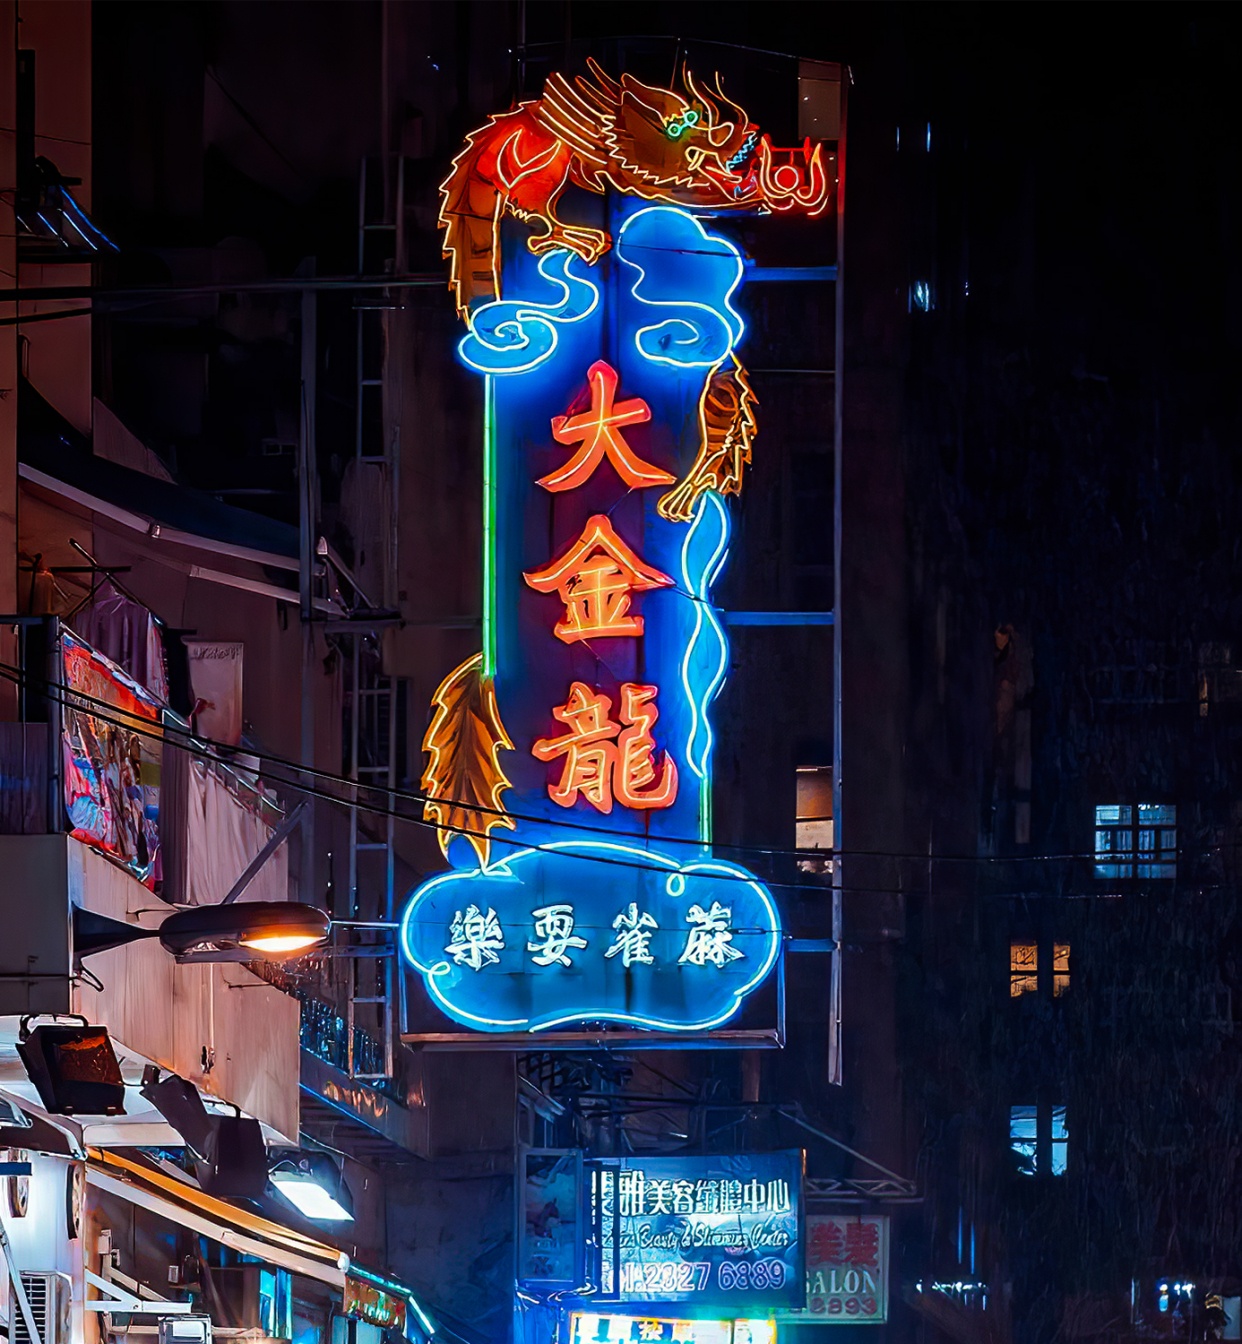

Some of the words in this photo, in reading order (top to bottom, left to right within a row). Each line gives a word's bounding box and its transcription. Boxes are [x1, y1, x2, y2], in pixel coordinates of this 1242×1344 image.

[522, 359, 679, 816] 大金龍
[718, 1260, 788, 1291] 6889
